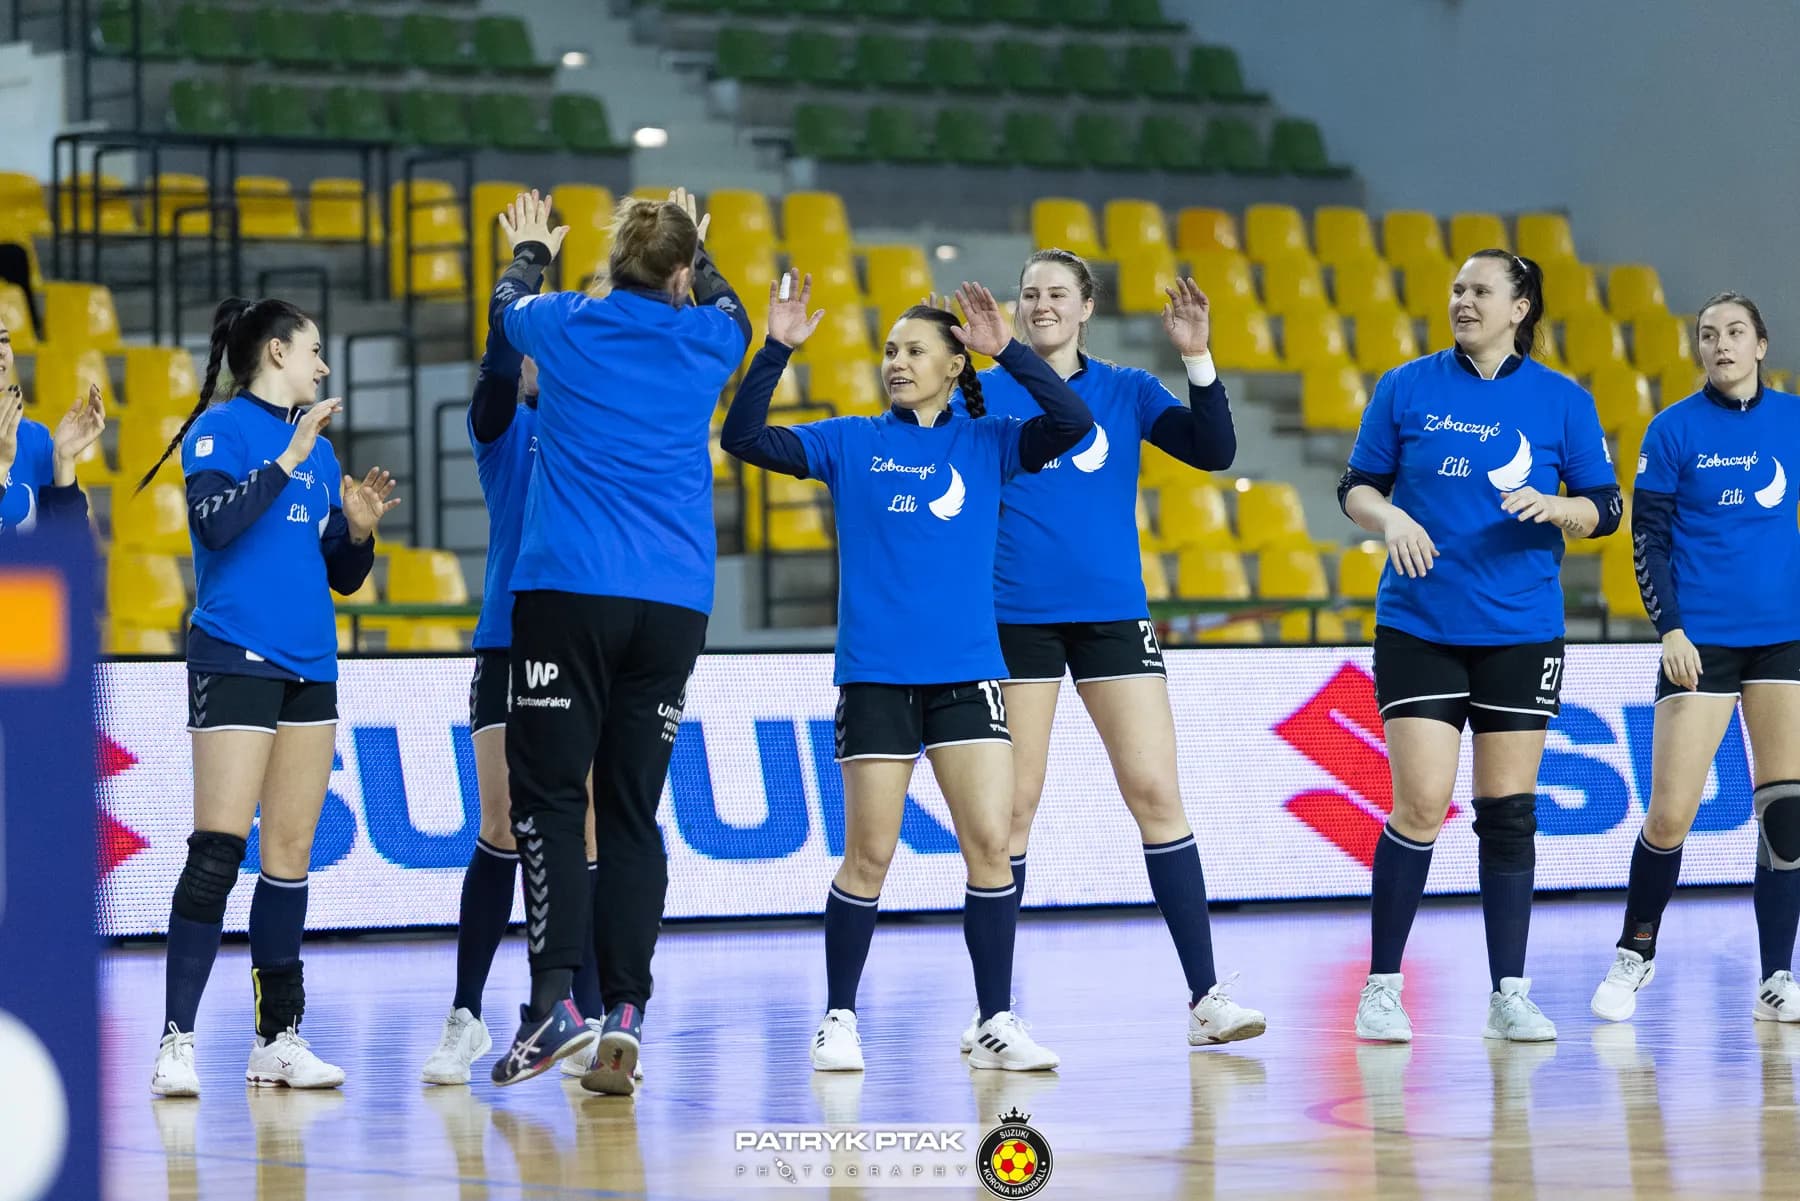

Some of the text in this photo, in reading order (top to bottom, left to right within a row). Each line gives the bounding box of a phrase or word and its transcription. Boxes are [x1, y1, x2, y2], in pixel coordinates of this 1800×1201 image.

[1424, 414, 1501, 442] Zobaczyć
[870, 456, 937, 480] Zobaczyć
[1437, 456, 1472, 478] Lili
[1696, 451, 1759, 472] Zobaczyć
[887, 494, 918, 512] Lili
[1718, 488, 1746, 506] Lili
[286, 503, 310, 523] Lili
[525, 659, 559, 689] WP
[1541, 657, 1562, 691] 27
